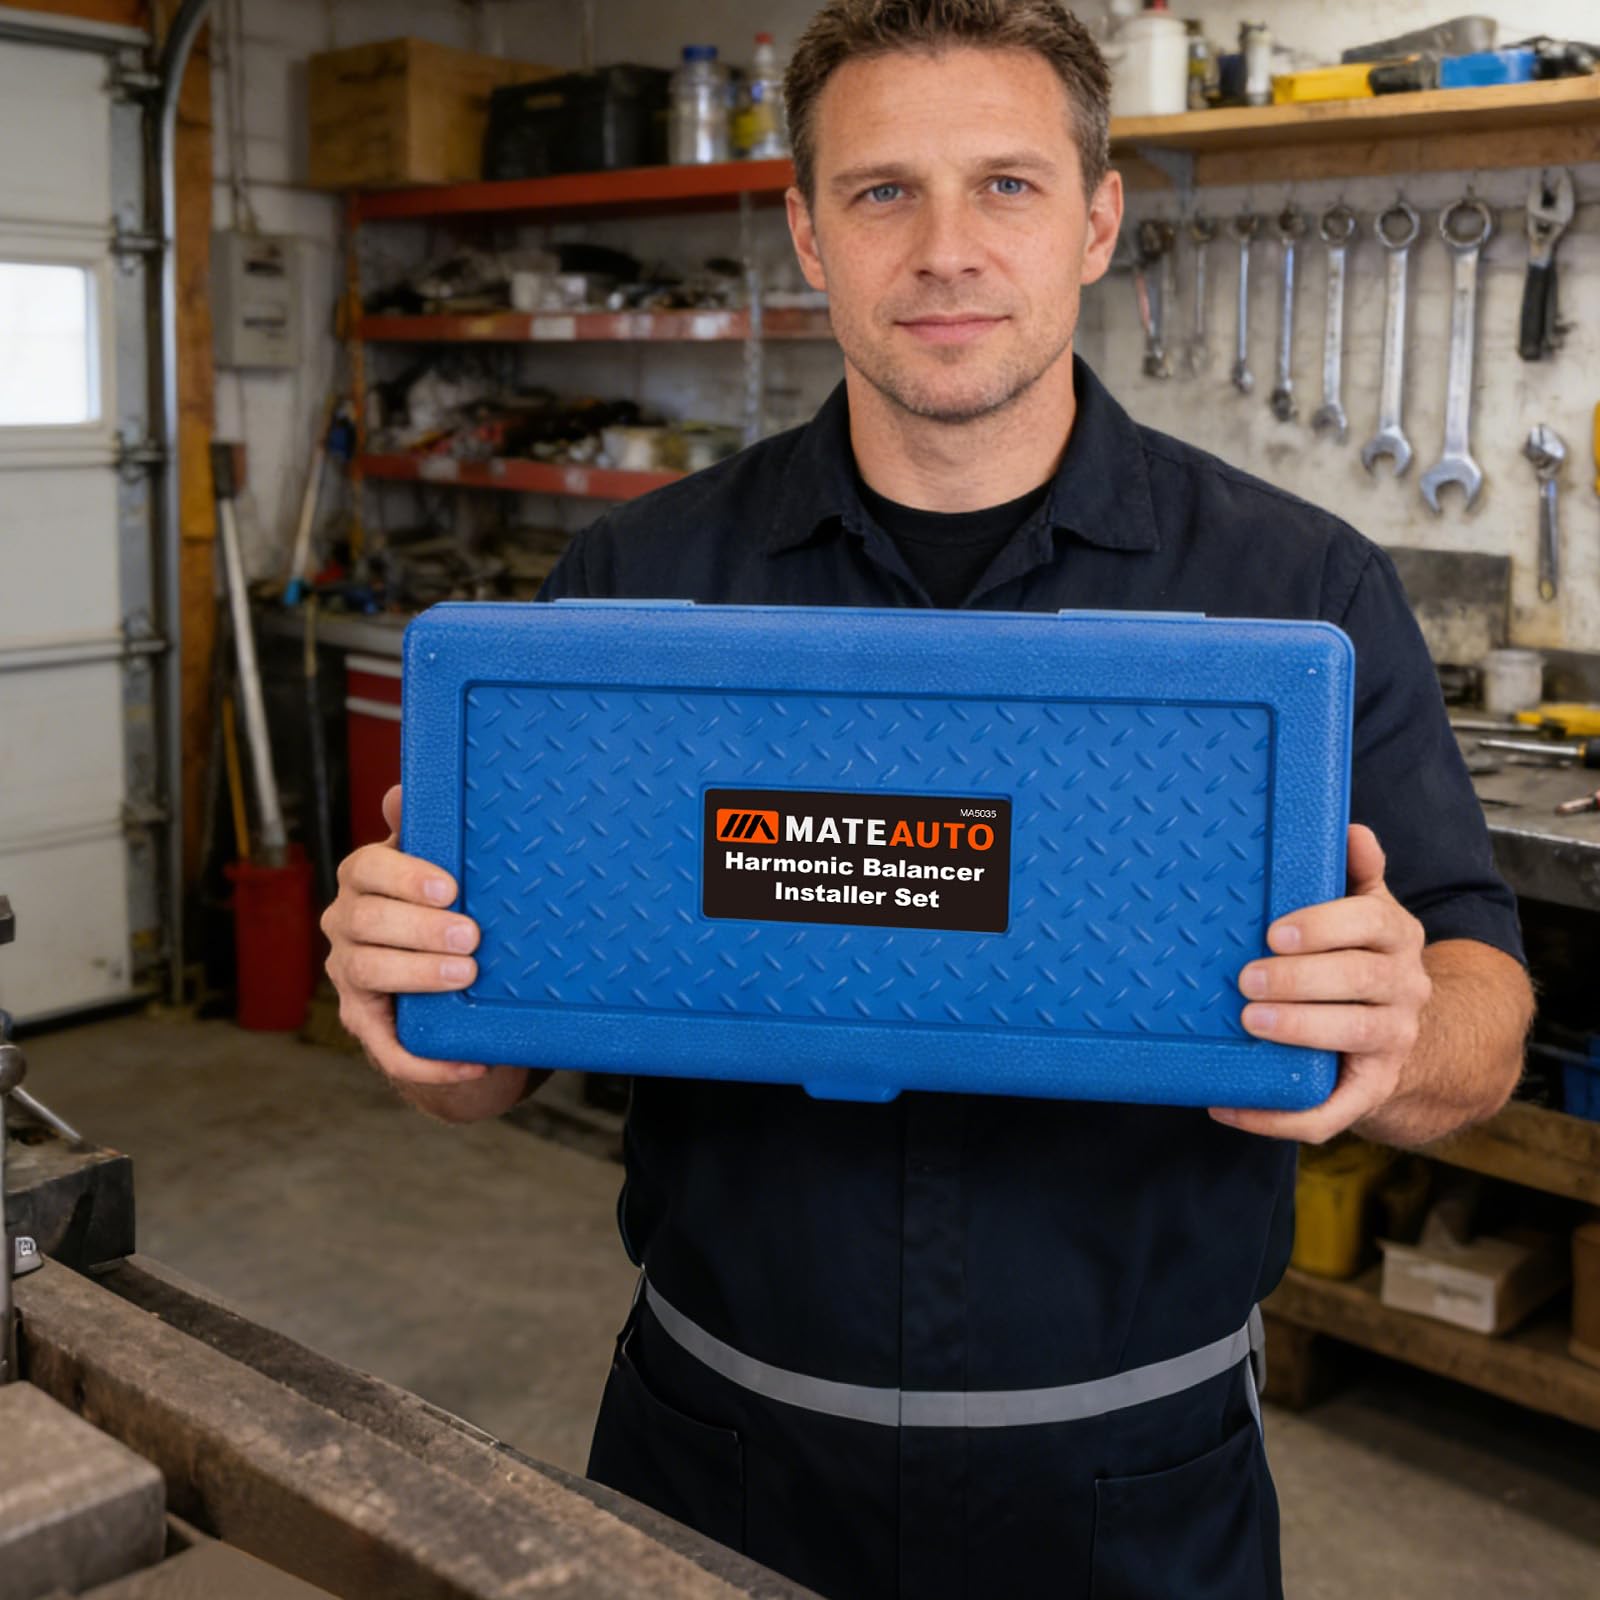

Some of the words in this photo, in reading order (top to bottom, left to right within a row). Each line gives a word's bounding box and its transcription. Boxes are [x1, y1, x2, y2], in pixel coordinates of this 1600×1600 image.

[960, 808, 997, 818] MA5035
[785, 815, 994, 851] MATEAUTO
[725, 851, 853, 875] Harmonic
[863, 858, 985, 881] Balancer
[775, 881, 887, 905] Installer
[894, 887, 940, 908] Set
